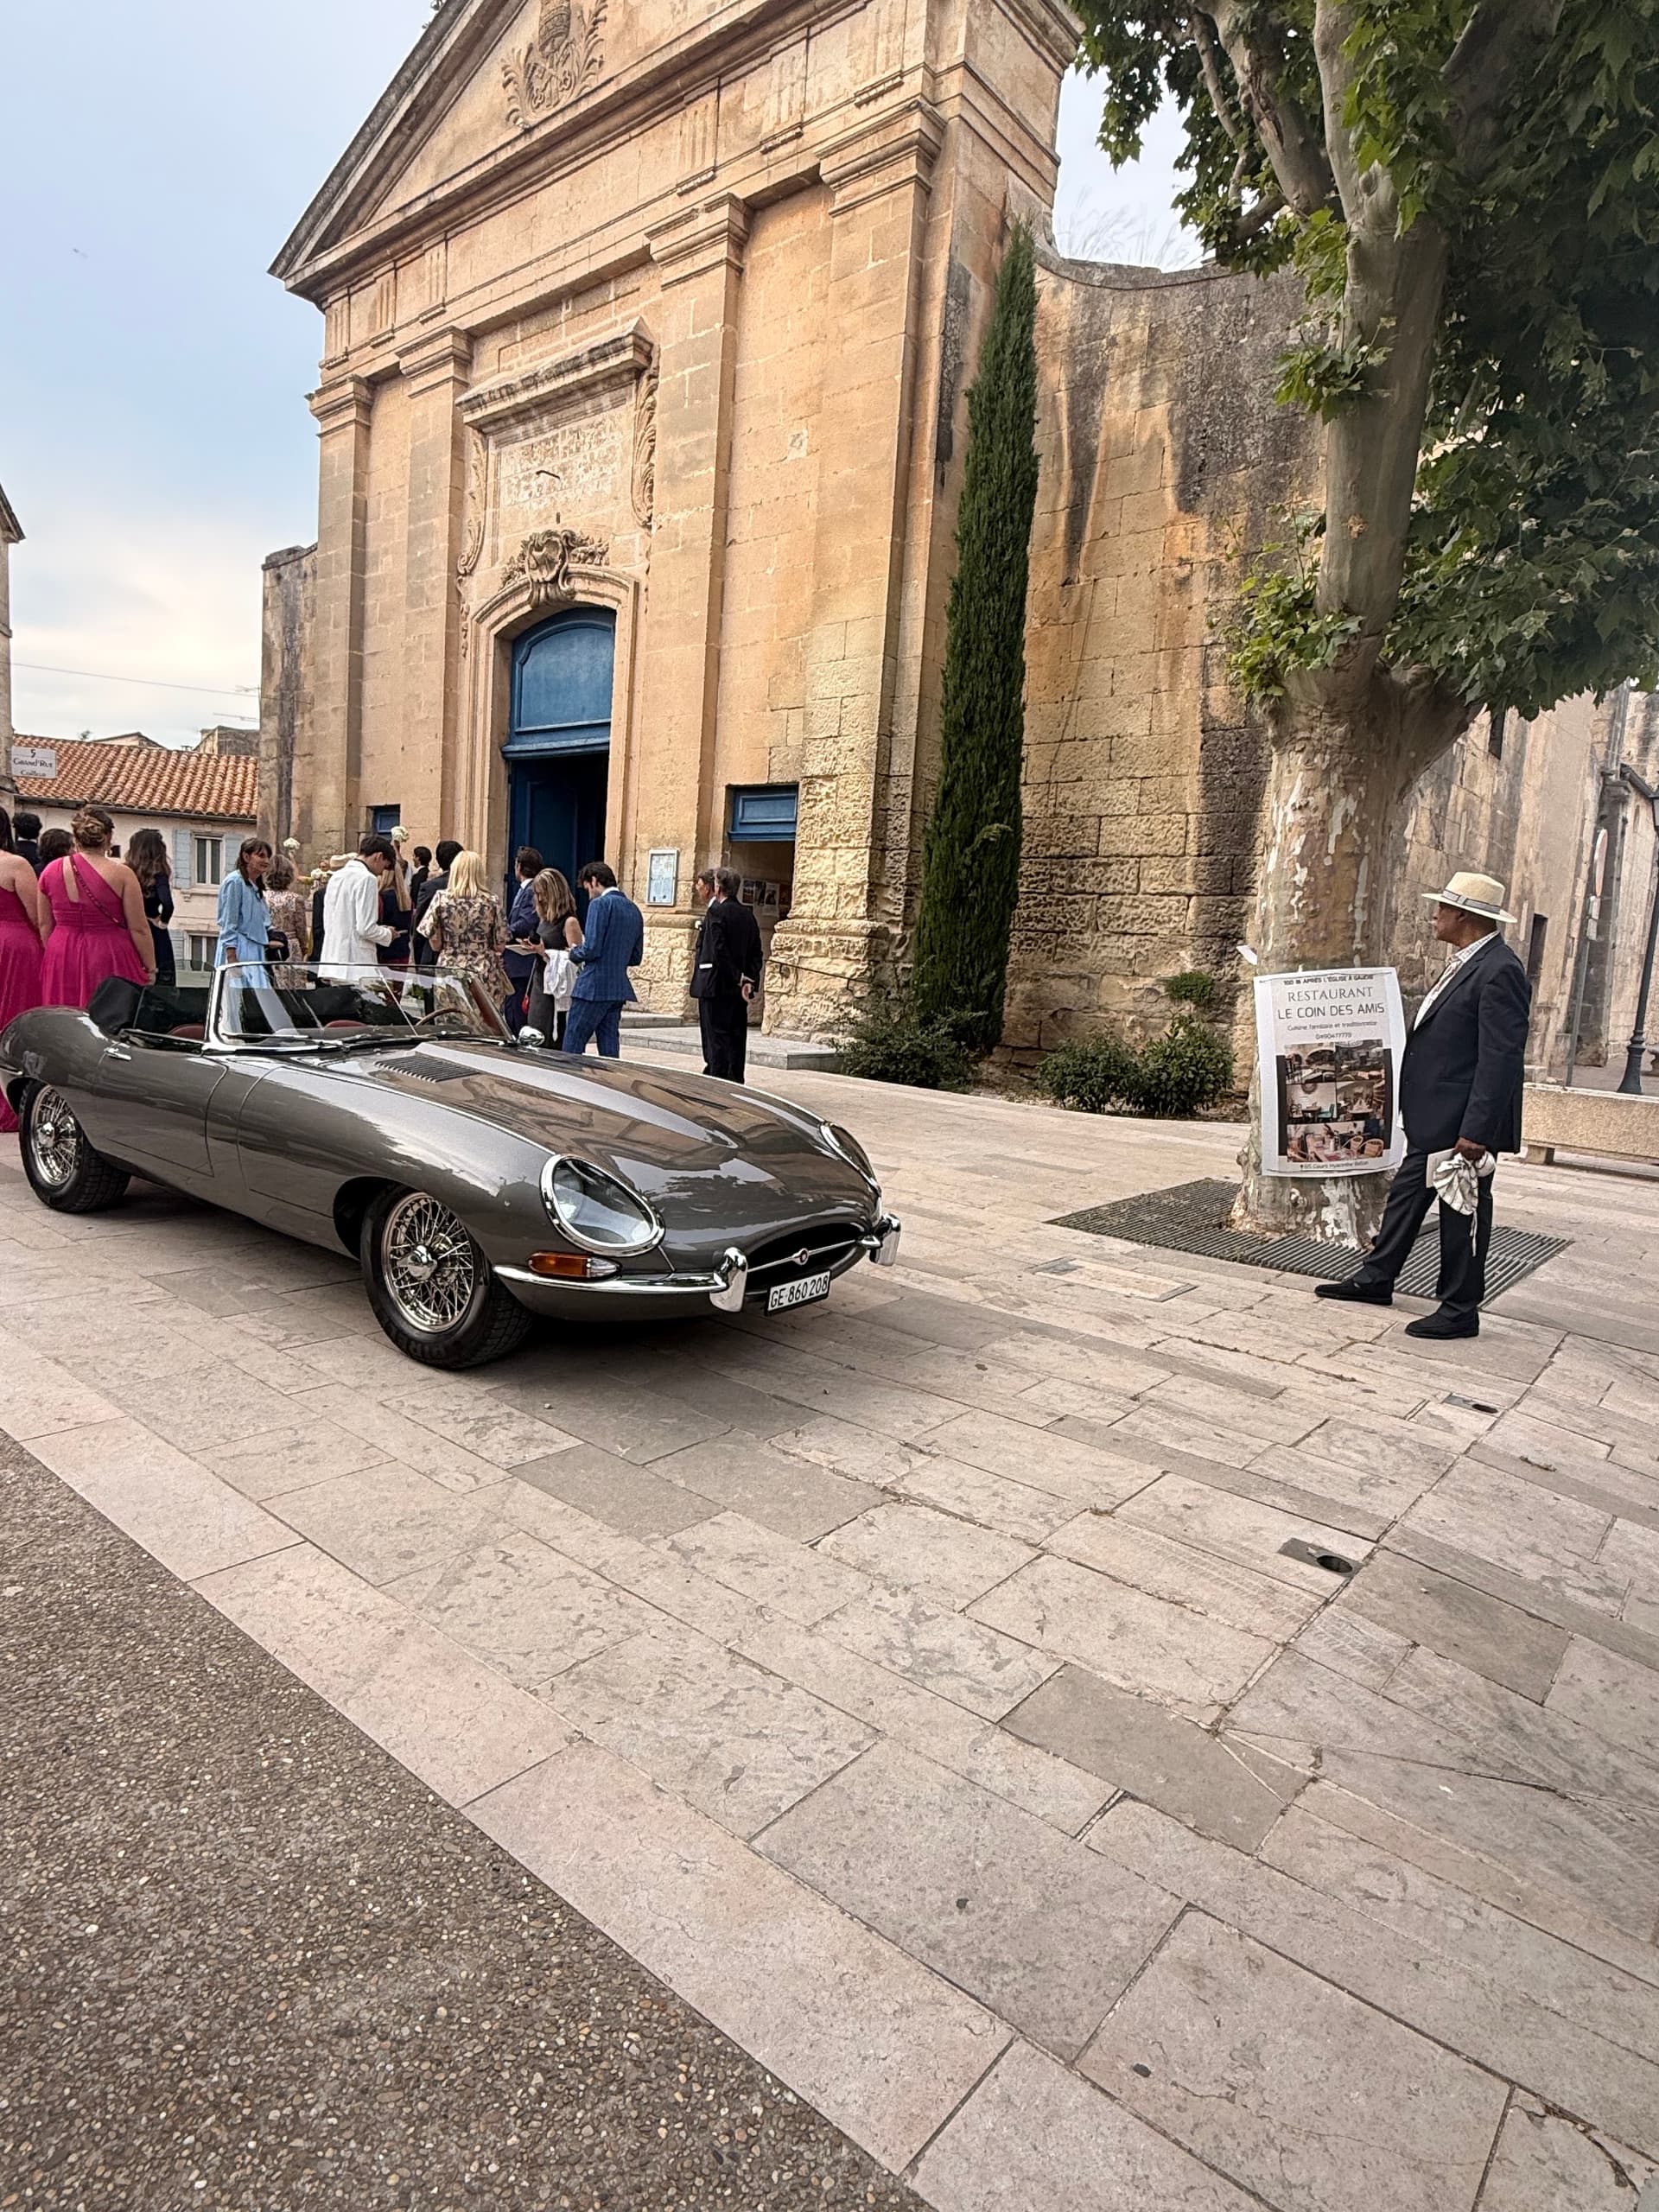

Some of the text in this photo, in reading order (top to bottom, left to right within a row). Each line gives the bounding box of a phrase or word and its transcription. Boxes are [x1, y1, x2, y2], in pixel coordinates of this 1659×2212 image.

[1287, 987, 1373, 1002] RESTAURANT
[1278, 1002, 1385, 1020] LE COIN DES AMIS
[808, 1274, 829, 1297] 208
